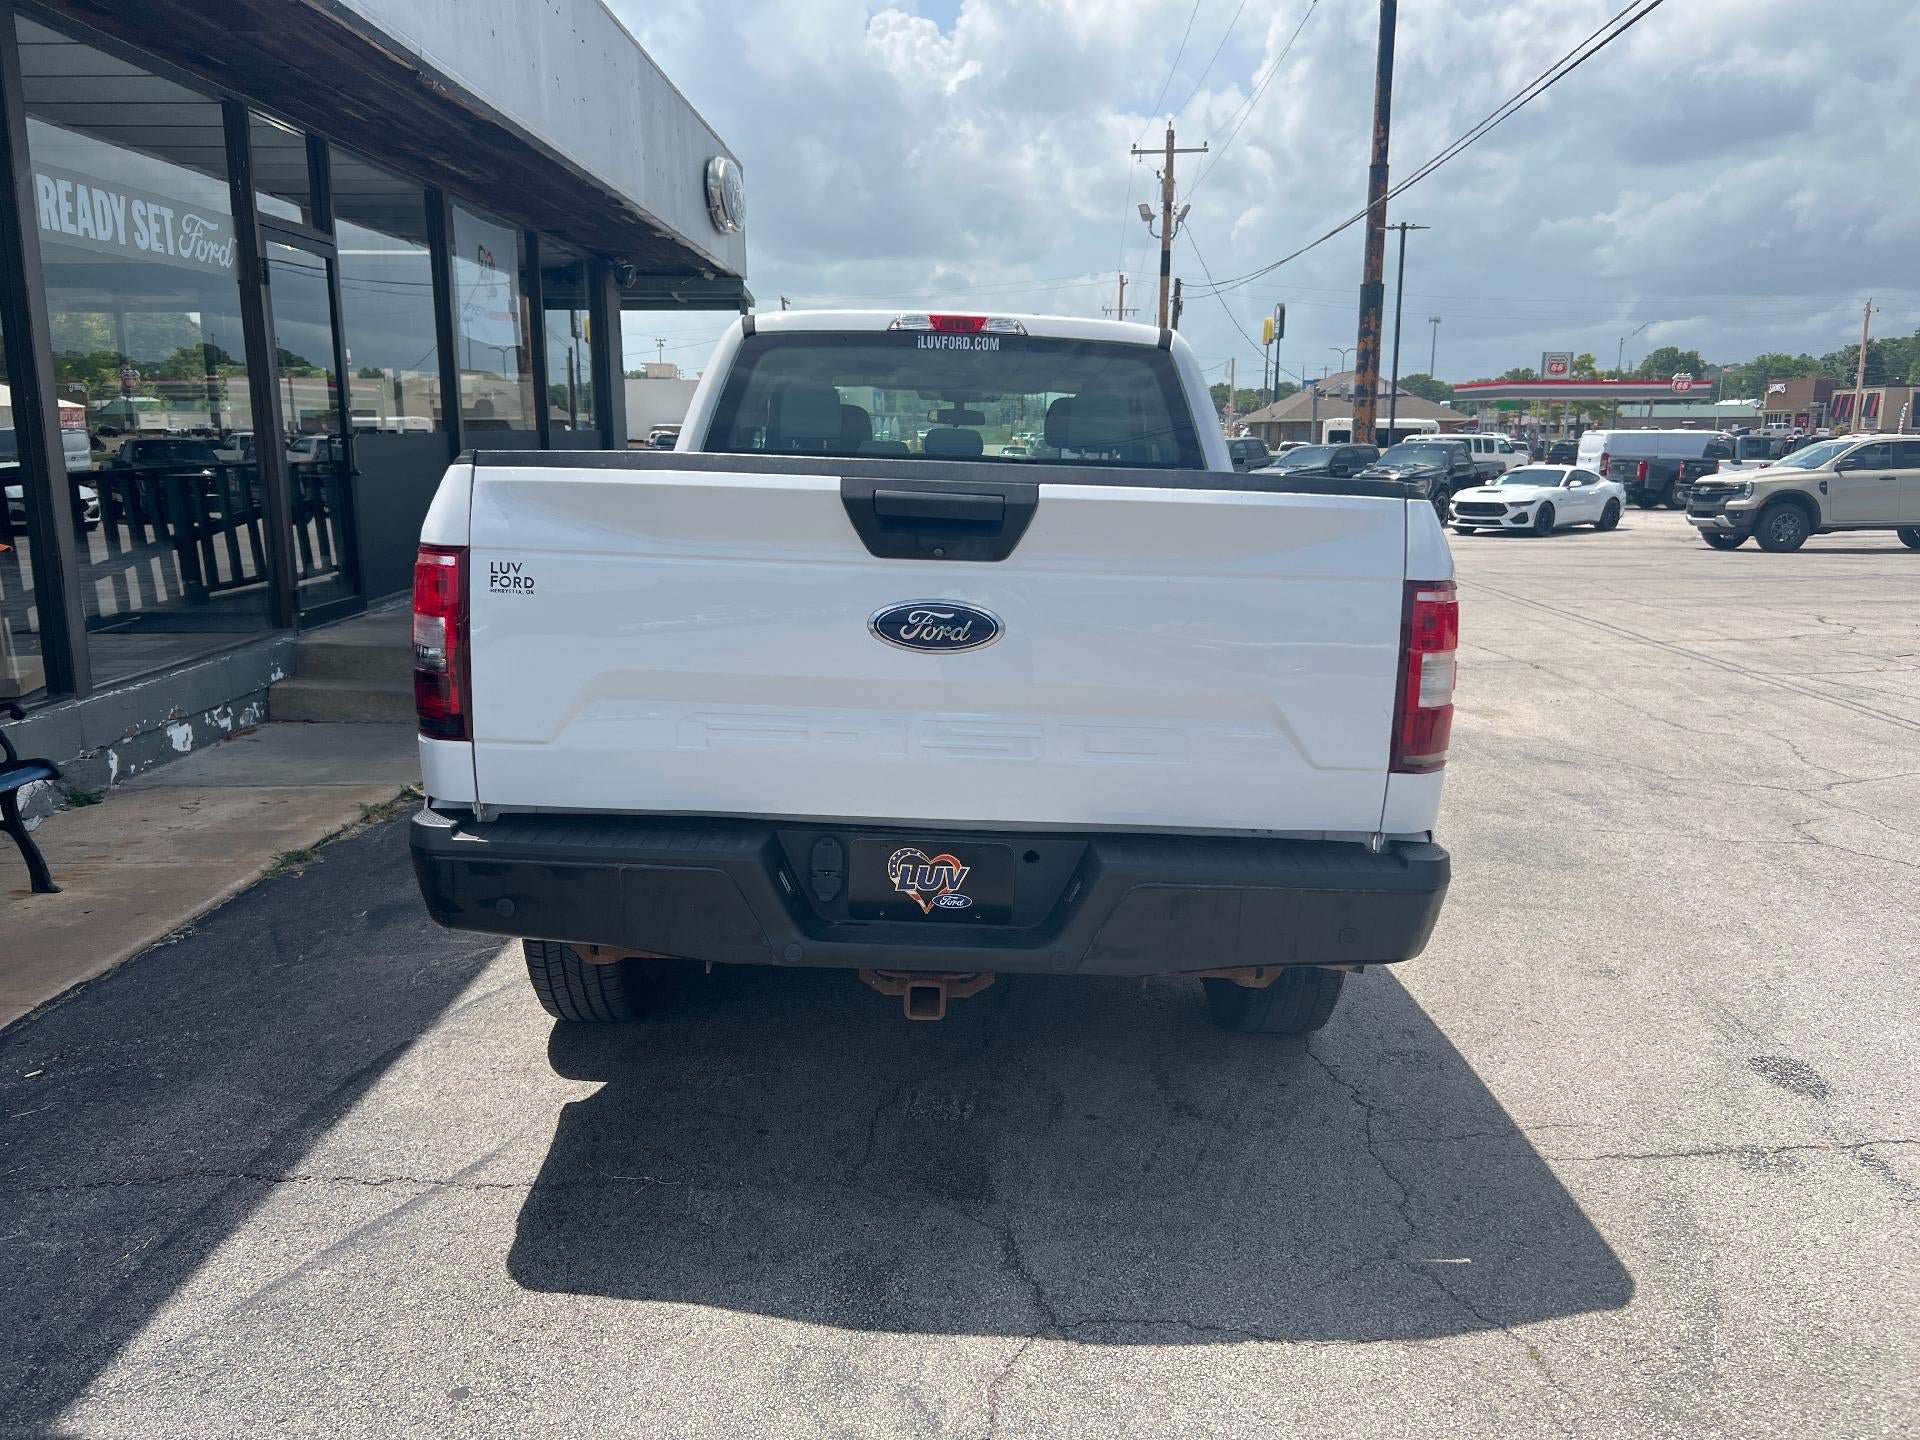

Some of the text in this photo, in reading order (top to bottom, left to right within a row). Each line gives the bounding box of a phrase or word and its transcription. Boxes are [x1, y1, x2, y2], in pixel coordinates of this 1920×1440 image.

[36, 173, 234, 268] READY SET Ford
[917, 335, 1000, 351] iLUVFORD.COM
[1550, 363, 1564, 372] 66
[1676, 381, 1689, 390] 66
[490, 561, 522, 574] LUV
[490, 575, 535, 588] FORD
[899, 610, 973, 641] Ford
[895, 864, 970, 891] LUV
[939, 896, 964, 907] Ford
